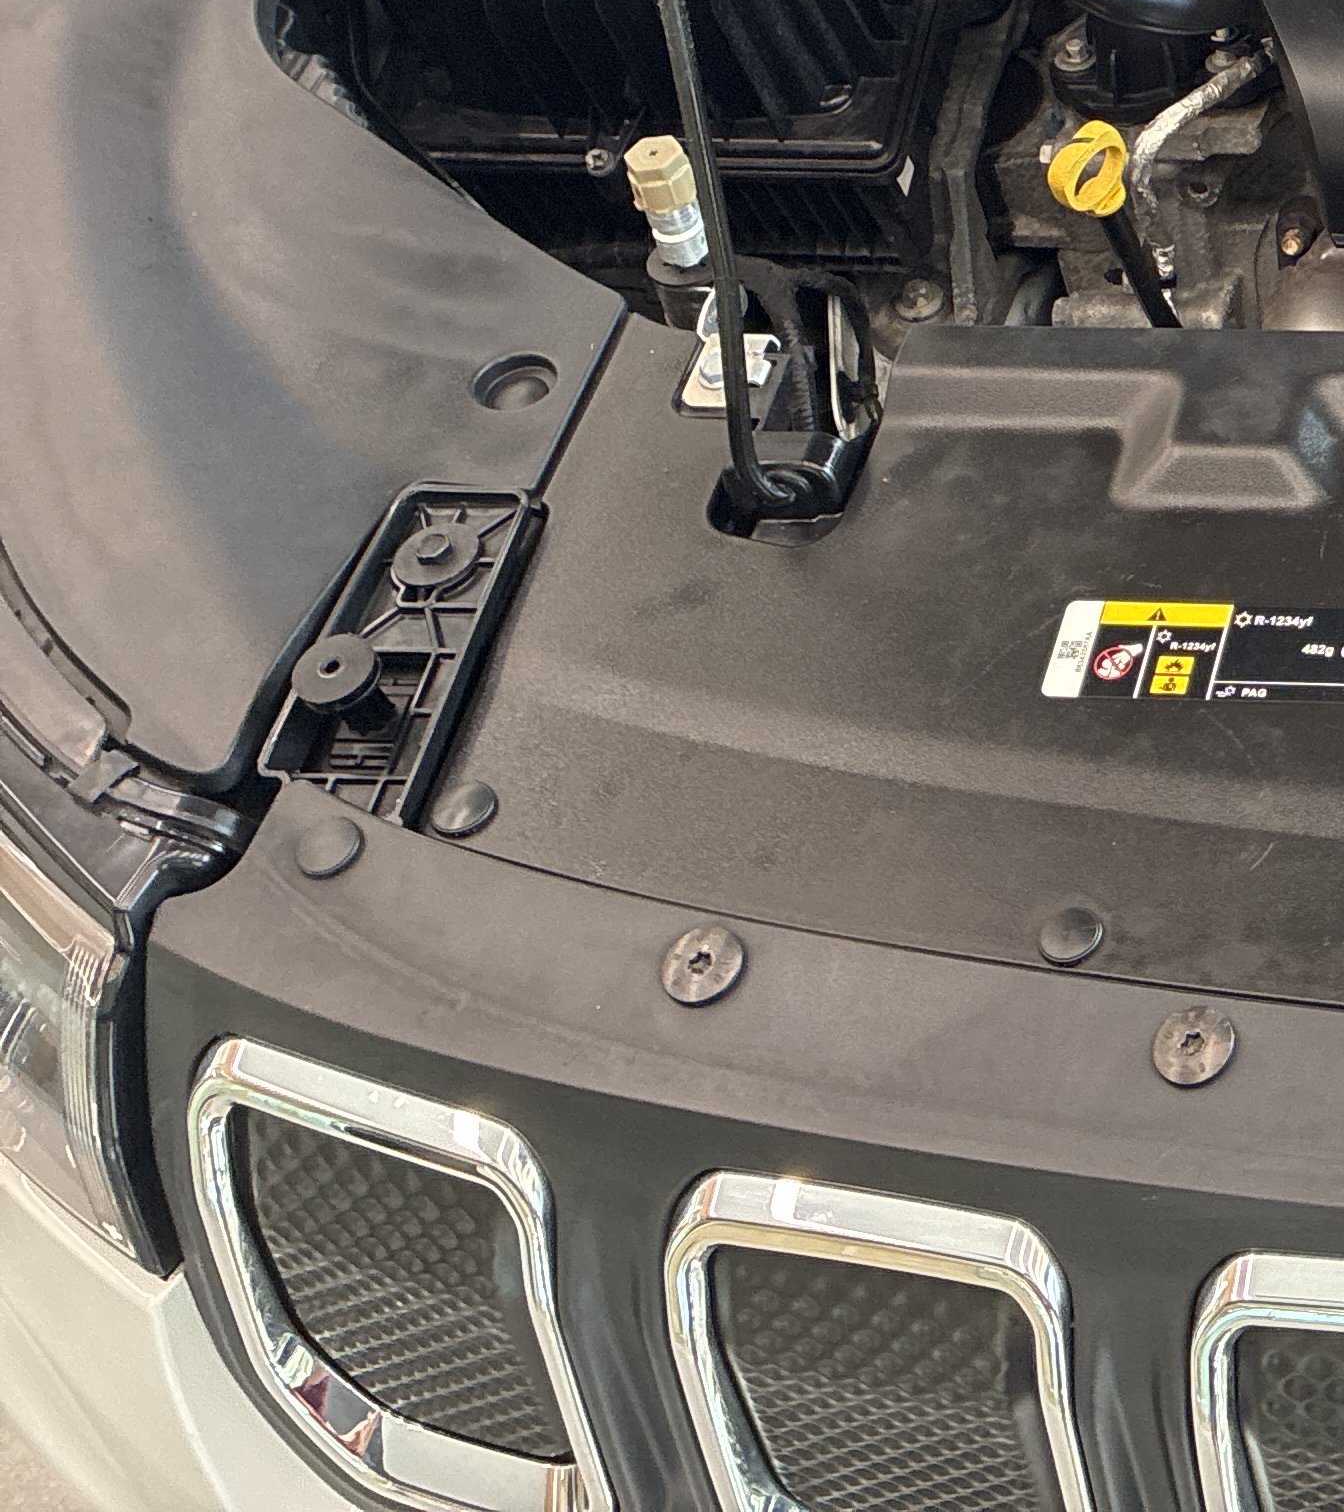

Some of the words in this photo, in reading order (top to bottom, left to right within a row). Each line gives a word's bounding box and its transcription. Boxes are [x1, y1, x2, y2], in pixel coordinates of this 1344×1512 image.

[1254, 615, 1315, 629] R-1234yf
[1169, 641, 1217, 653] R-1234yf
[1301, 643, 1335, 658] 482g
[1240, 687, 1268, 698] PAG
